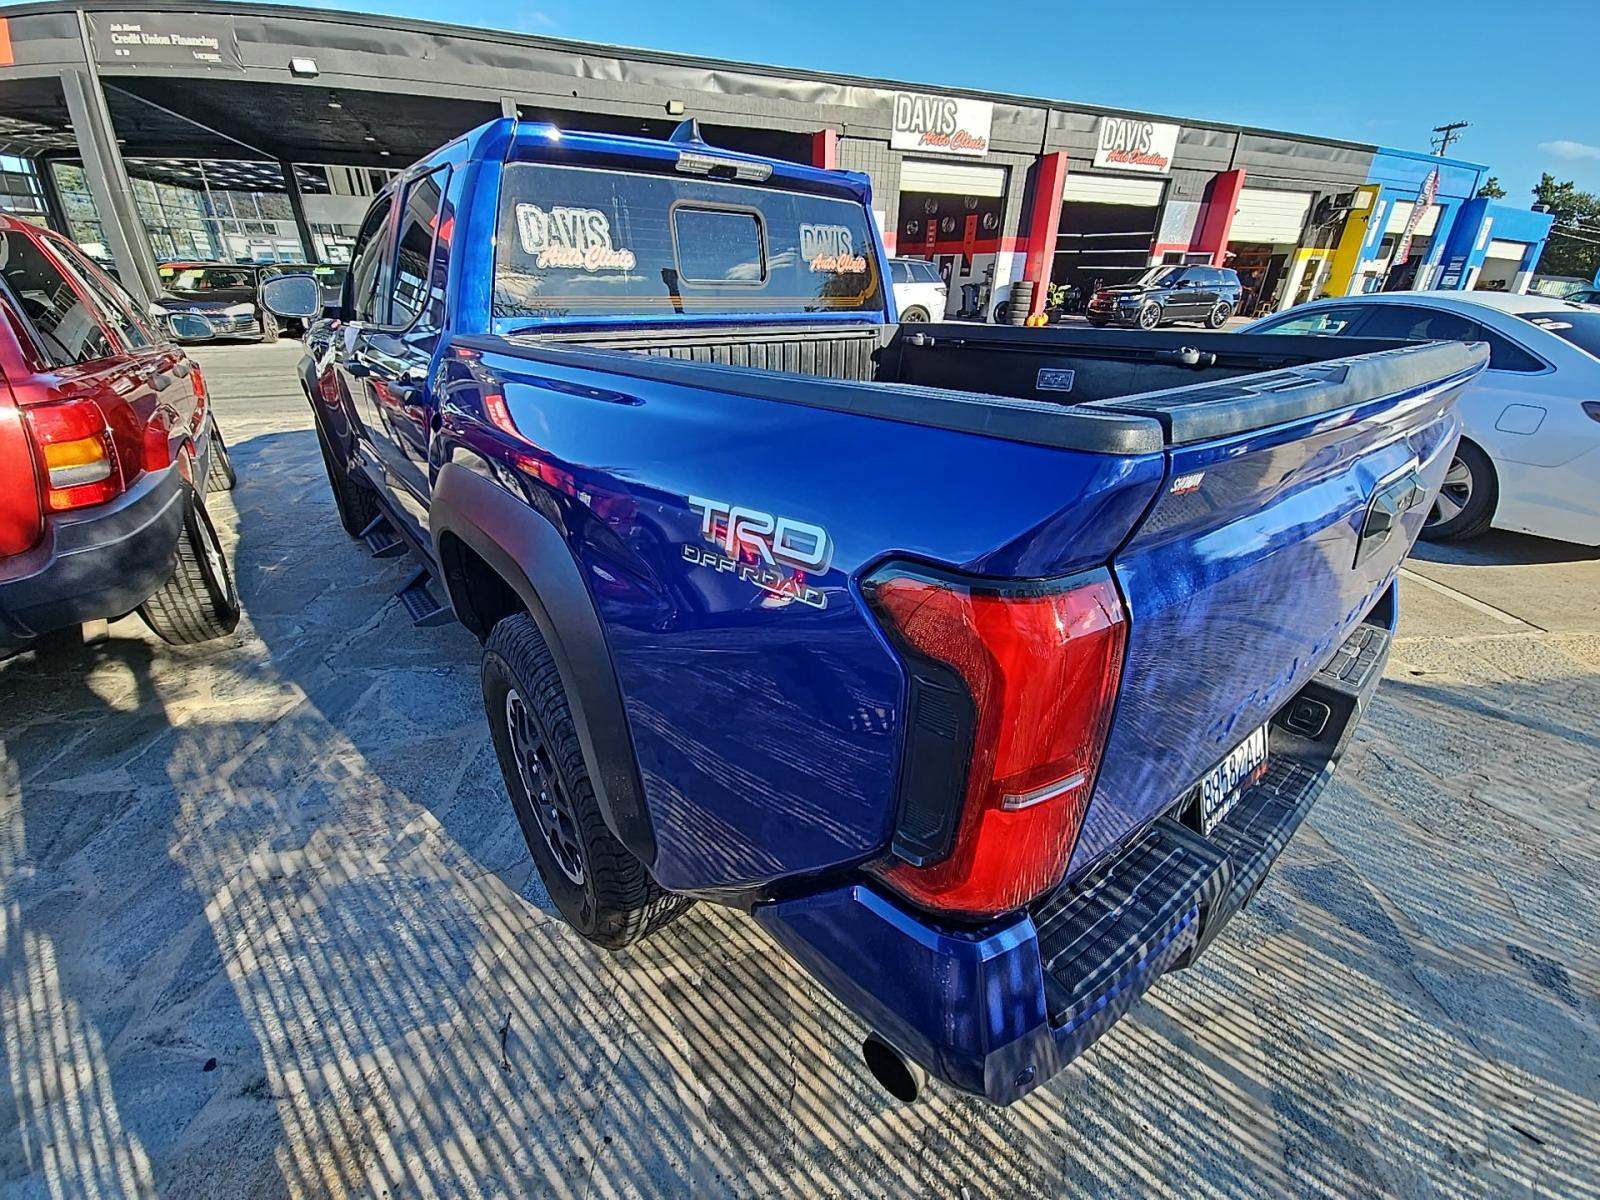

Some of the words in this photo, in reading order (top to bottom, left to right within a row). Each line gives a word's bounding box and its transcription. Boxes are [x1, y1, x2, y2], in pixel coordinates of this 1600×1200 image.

[111, 33, 141, 45] Credit
[141, 33, 170, 45] Union
[170, 34, 219, 50] Financing
[896, 93, 957, 136] DAVIS
[918, 130, 950, 147] Auto
[950, 129, 986, 150] Clinic
[1102, 119, 1153, 154] DAVIS
[1106, 149, 1129, 163] Auto
[1129, 147, 1168, 170] Detailing
[518, 205, 610, 252] DAVIS
[801, 225, 852, 261] DAVIS
[537, 245, 583, 269] Auto
[584, 245, 635, 272] Clinic
[809, 253, 836, 273] Auto
[836, 253, 867, 274] Clinic
[688, 495, 834, 576] TRD
[681, 543, 737, 575] OFF
[738, 561, 829, 610] ROAD
